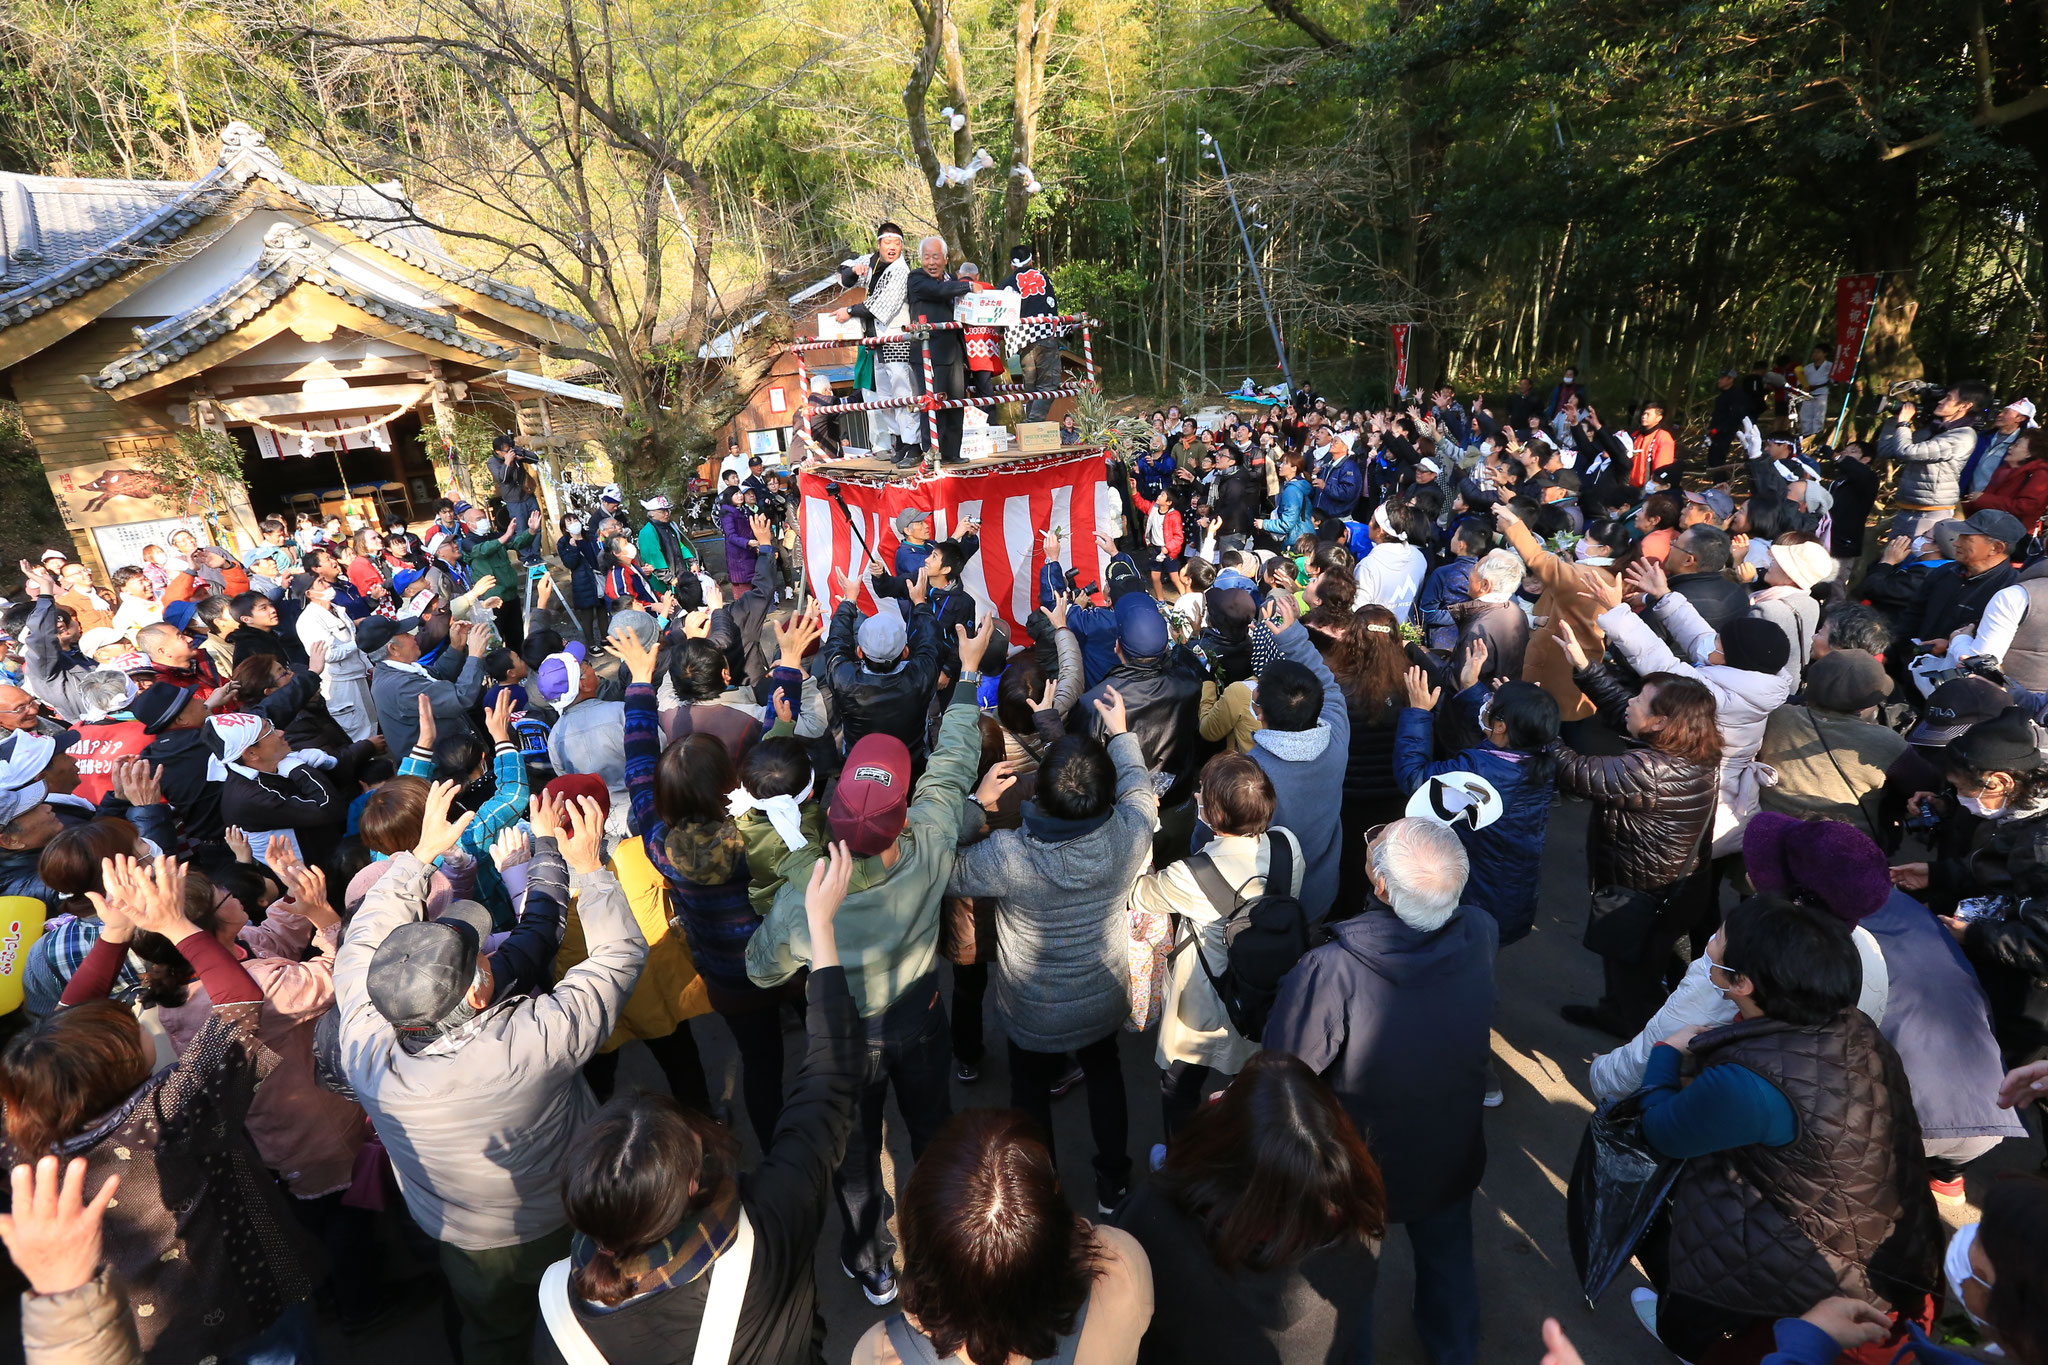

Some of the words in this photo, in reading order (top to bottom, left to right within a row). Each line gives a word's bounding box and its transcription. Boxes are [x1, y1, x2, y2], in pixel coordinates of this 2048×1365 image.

[1016, 269, 1046, 299] 祭
[59, 473, 76, 493] 開運
[1928, 706, 1956, 718] FILA
